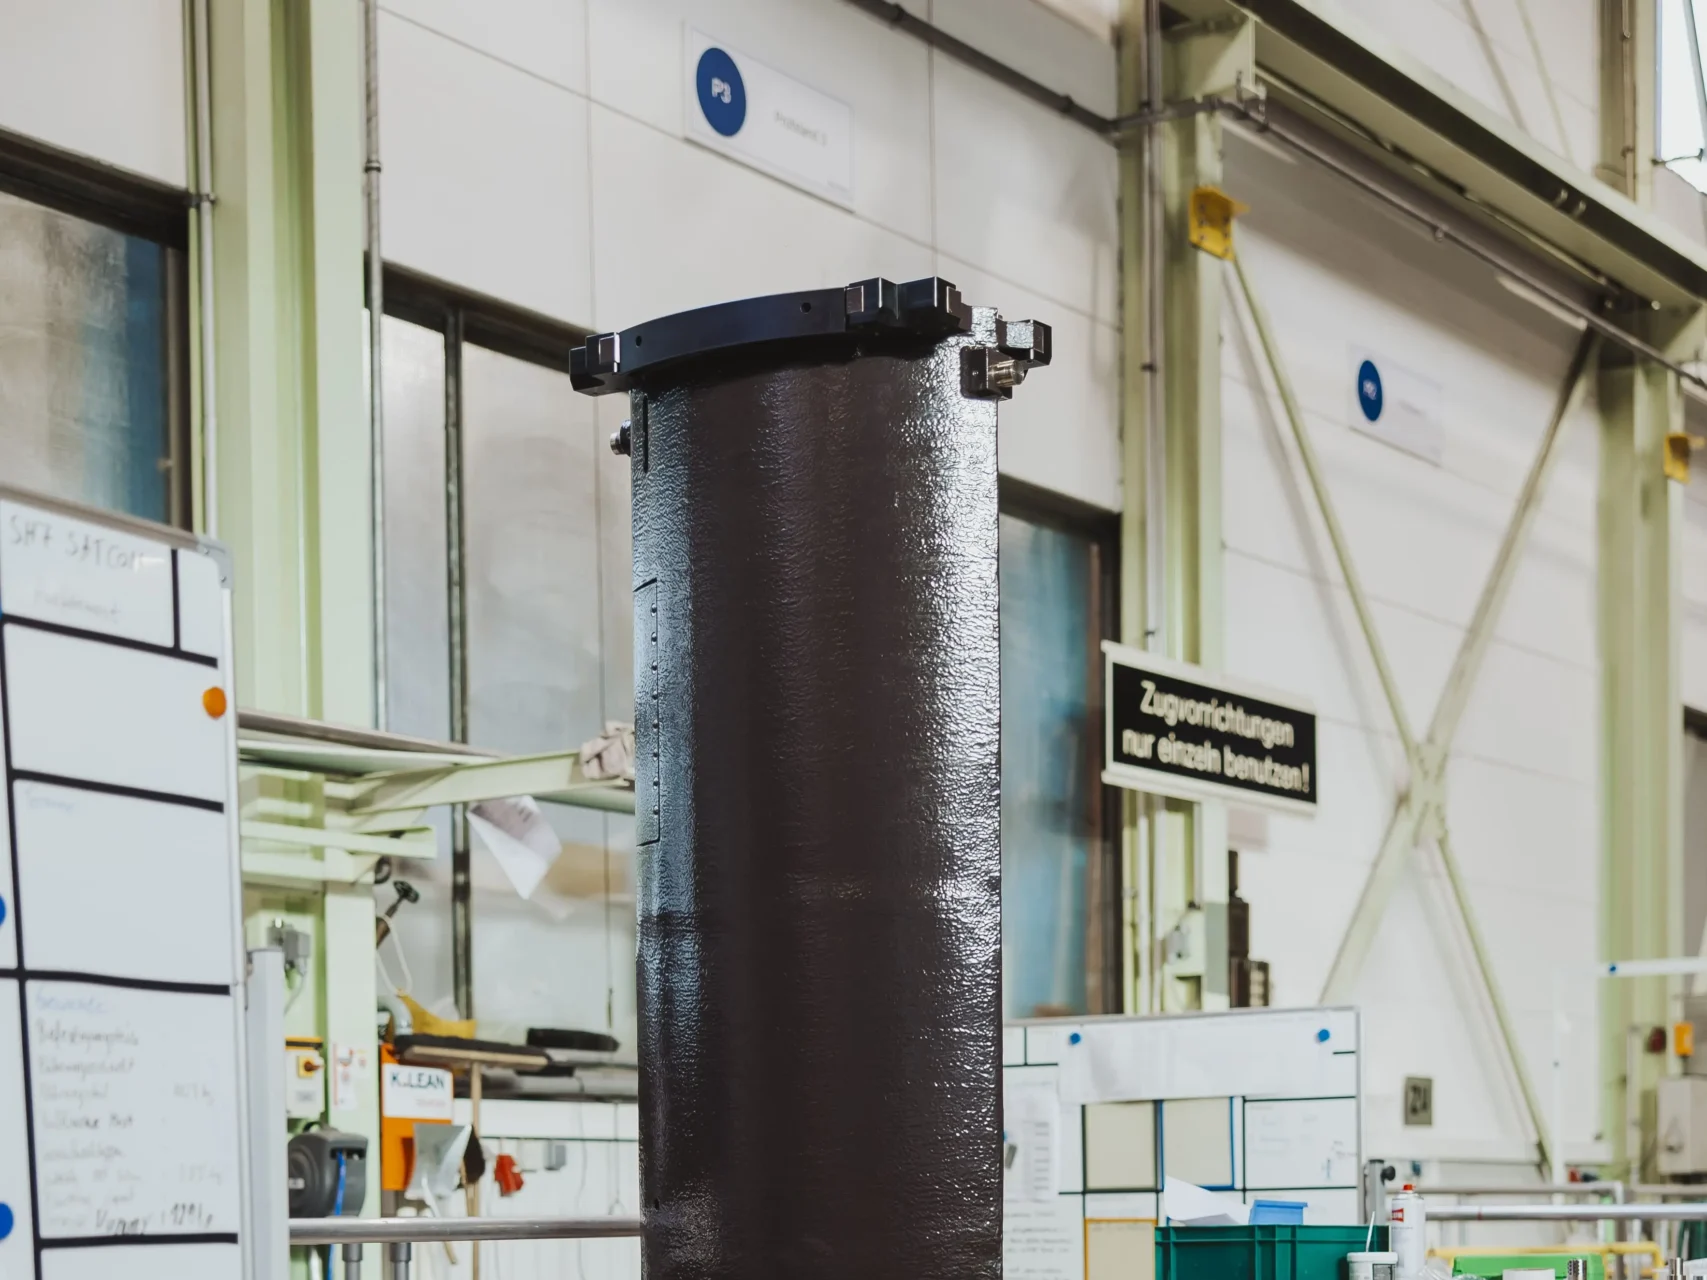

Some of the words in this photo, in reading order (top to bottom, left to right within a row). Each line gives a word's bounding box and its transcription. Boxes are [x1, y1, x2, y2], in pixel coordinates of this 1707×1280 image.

[711, 77, 732, 104] P3
[1140, 679, 1295, 749] Zugvorrichtungen
[1122, 728, 1156, 760] nur
[1157, 731, 1222, 775] einzeln
[1223, 745, 1310, 793] benutzen!
